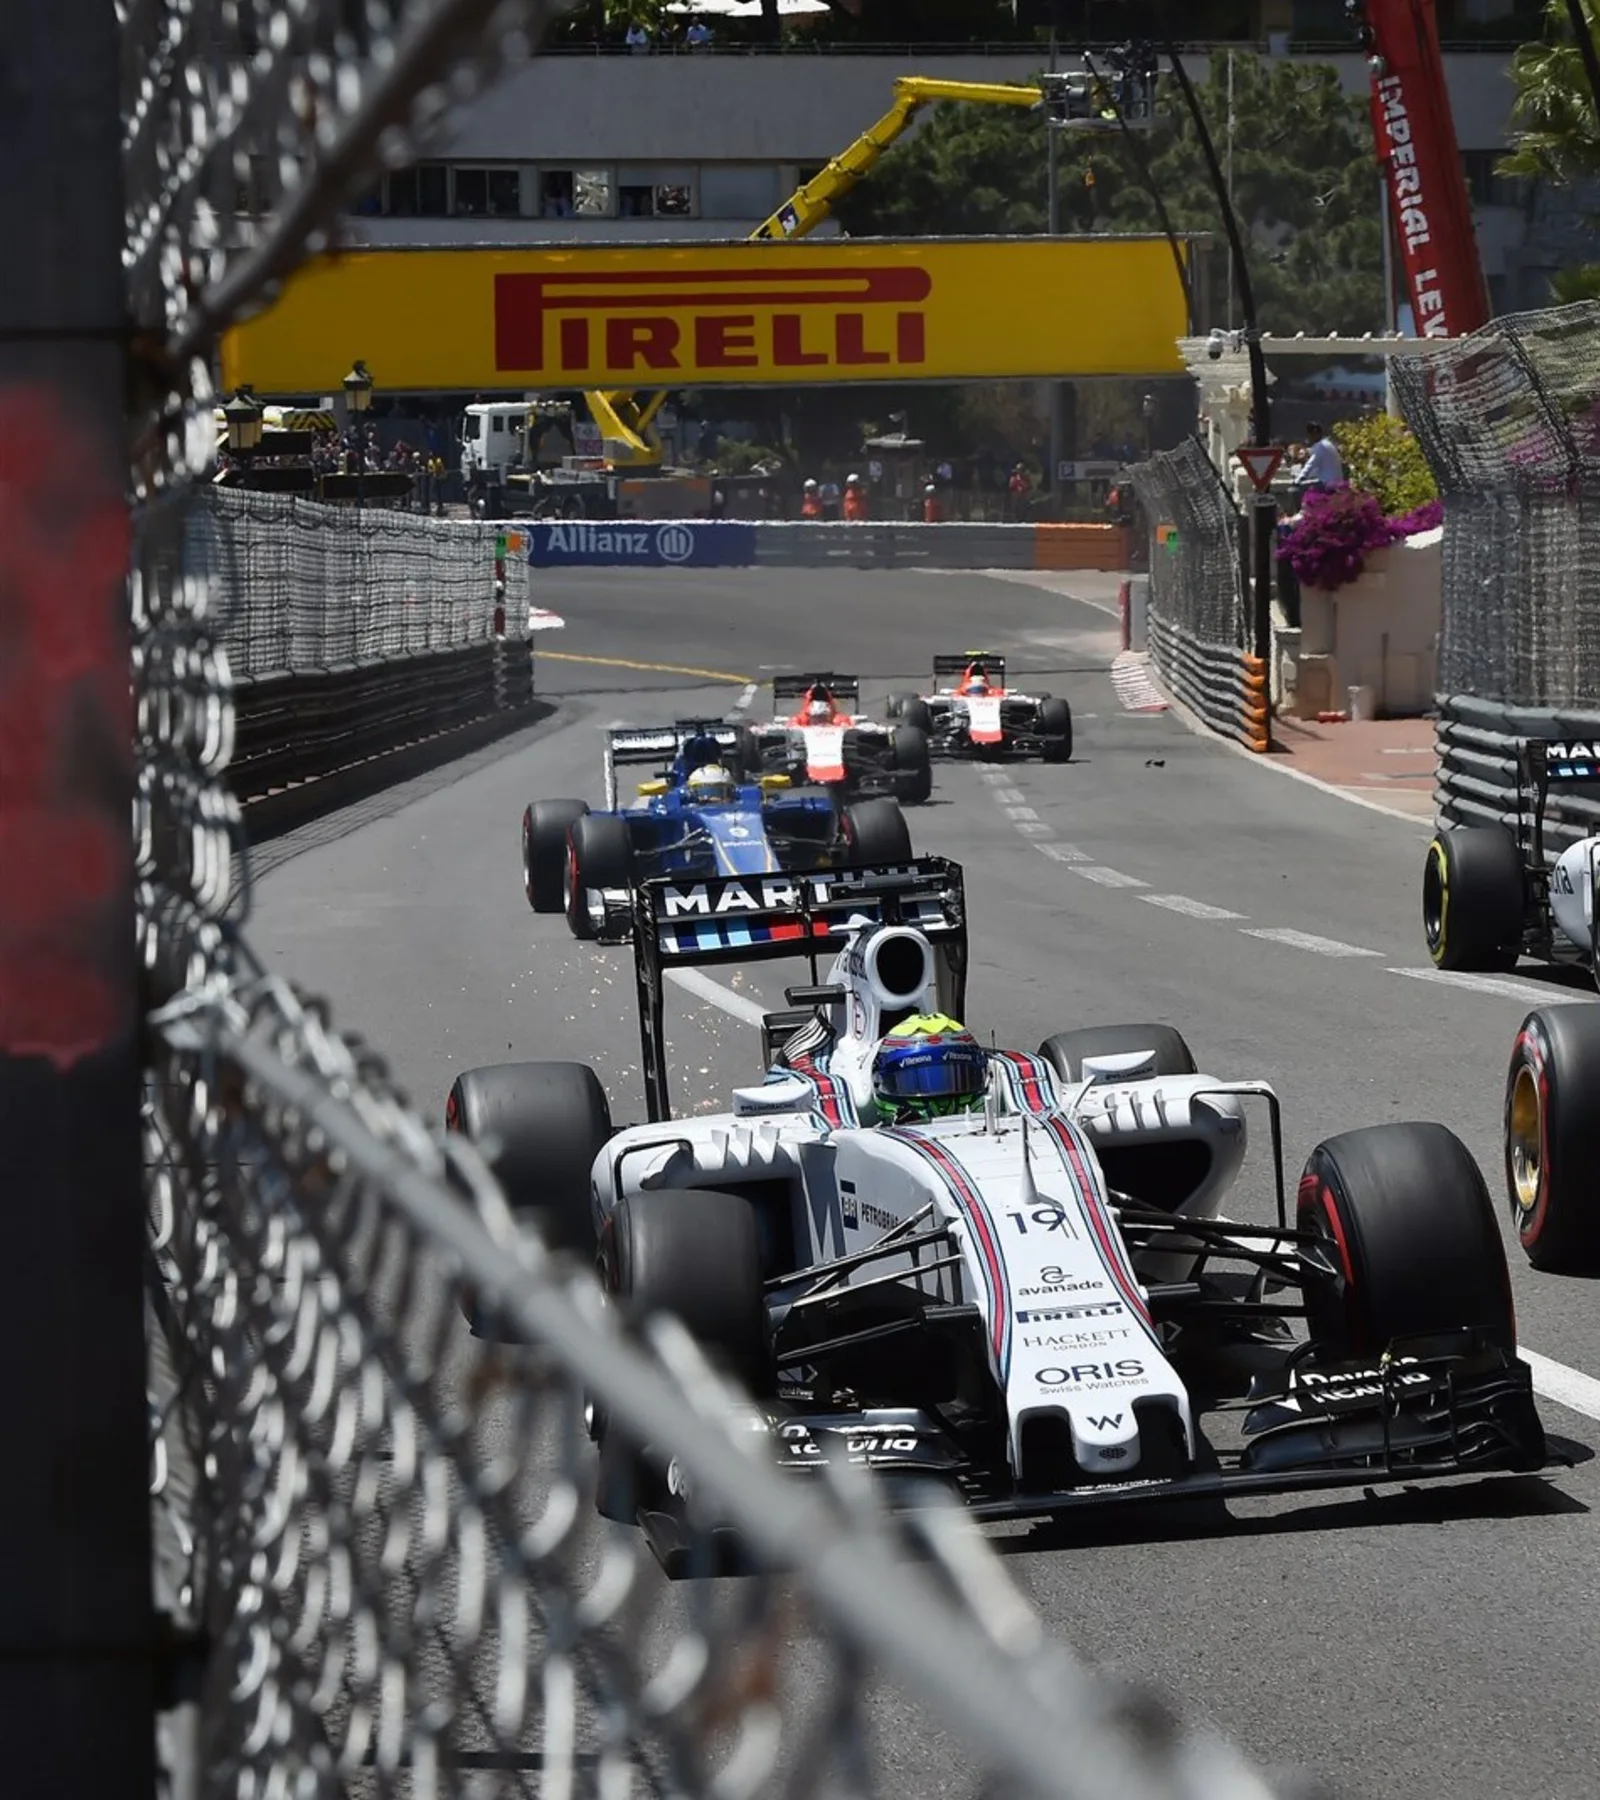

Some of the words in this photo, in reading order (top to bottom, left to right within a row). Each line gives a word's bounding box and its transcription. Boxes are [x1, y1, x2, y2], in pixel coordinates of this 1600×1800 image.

[1377, 75, 1431, 255] IMPERIAL
[494, 267, 932, 371] PIRELLI
[547, 526, 649, 553] Allianz
[1006, 1208, 1067, 1235] 19
[1018, 1279, 1104, 1297] avanade
[1015, 1302, 1124, 1324] PIRELLI
[1023, 1328, 1131, 1348] HACKETT
[1053, 1342, 1107, 1352] LONDON
[1035, 1359, 1145, 1386] ORIS
[1039, 1384, 1083, 1396] Swiss
[1086, 1377, 1150, 1394] Watches
